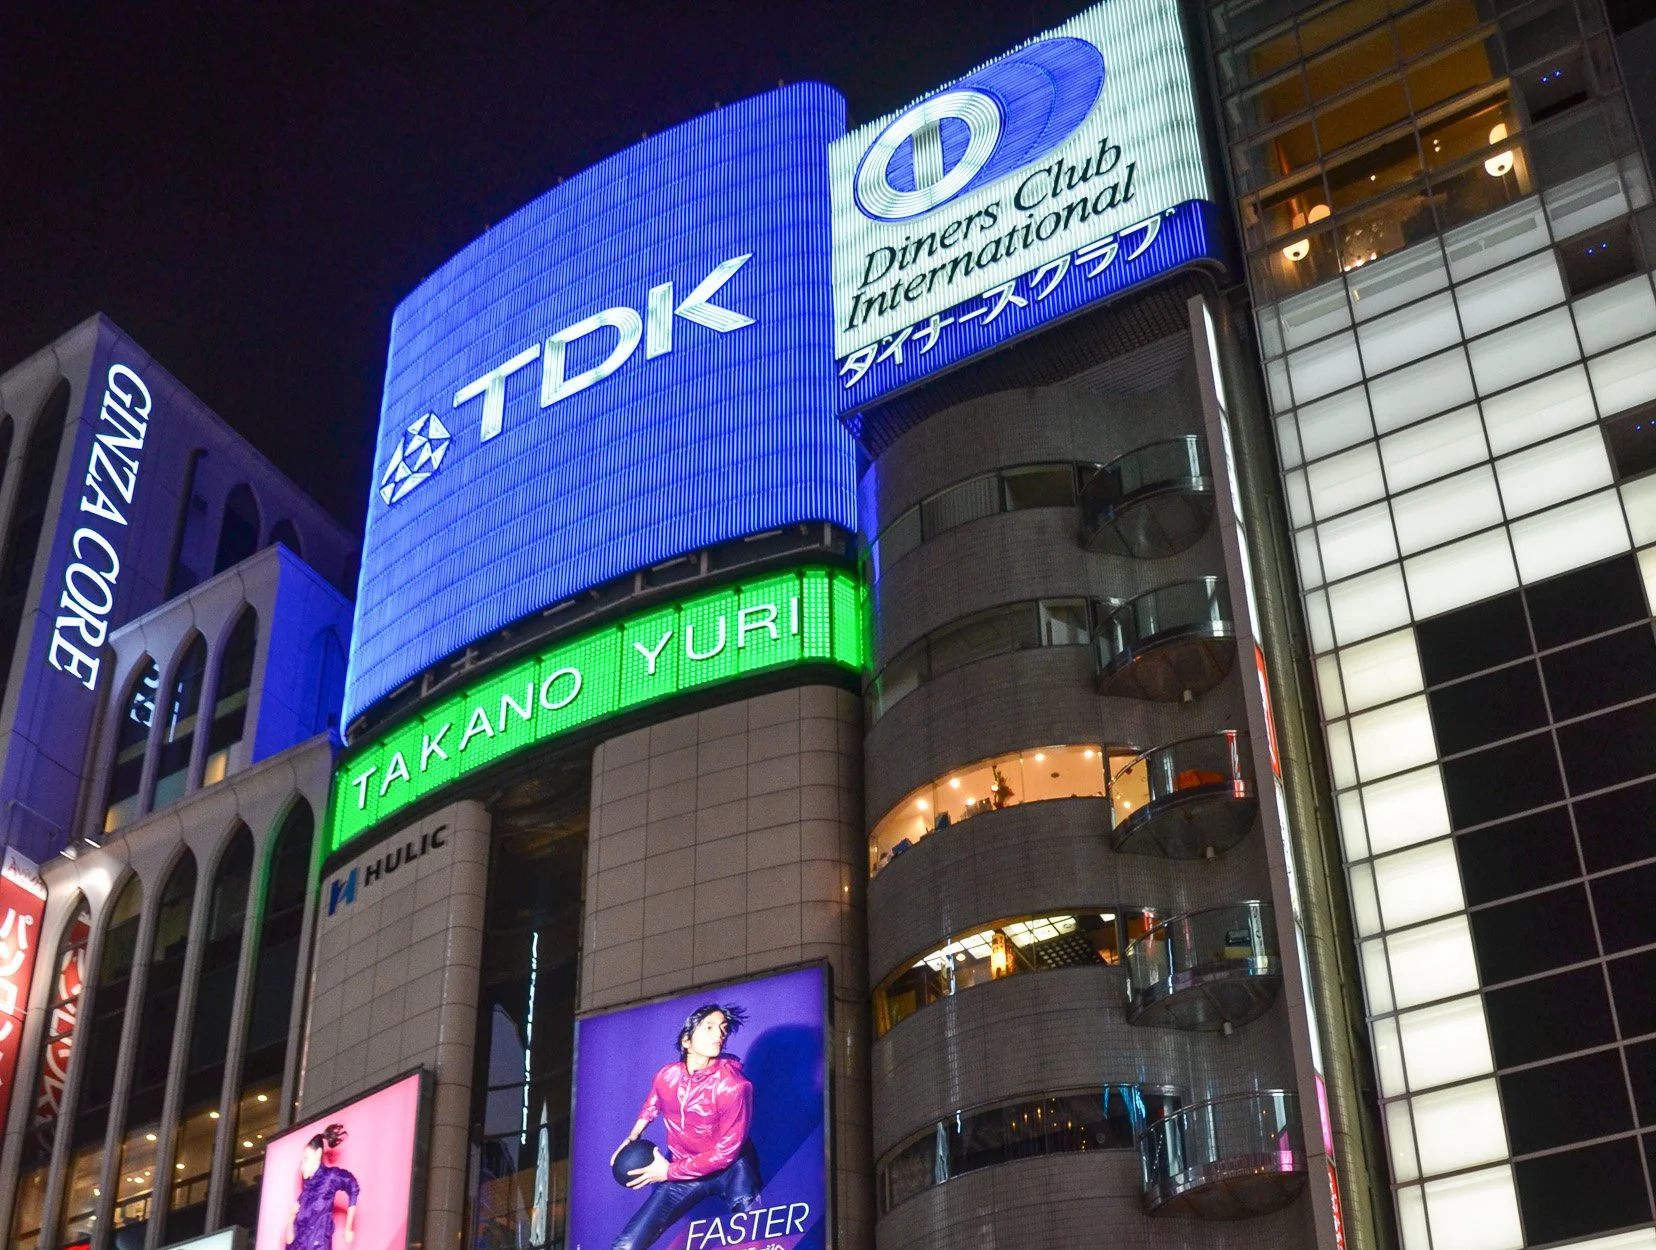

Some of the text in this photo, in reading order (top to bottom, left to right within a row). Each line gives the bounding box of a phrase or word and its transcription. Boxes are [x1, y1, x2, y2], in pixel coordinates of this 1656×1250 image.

[839, 208, 1176, 388] ダイナースクラブ
[843, 161, 1137, 332] International
[859, 137, 1121, 289] Diners Club
[453, 253, 757, 443] TDK
[48, 363, 152, 690] GINZA CORE
[352, 597, 799, 810] TAKANO YURI
[363, 825, 447, 887] HULIC
[686, 1203, 810, 1250] FASTER
